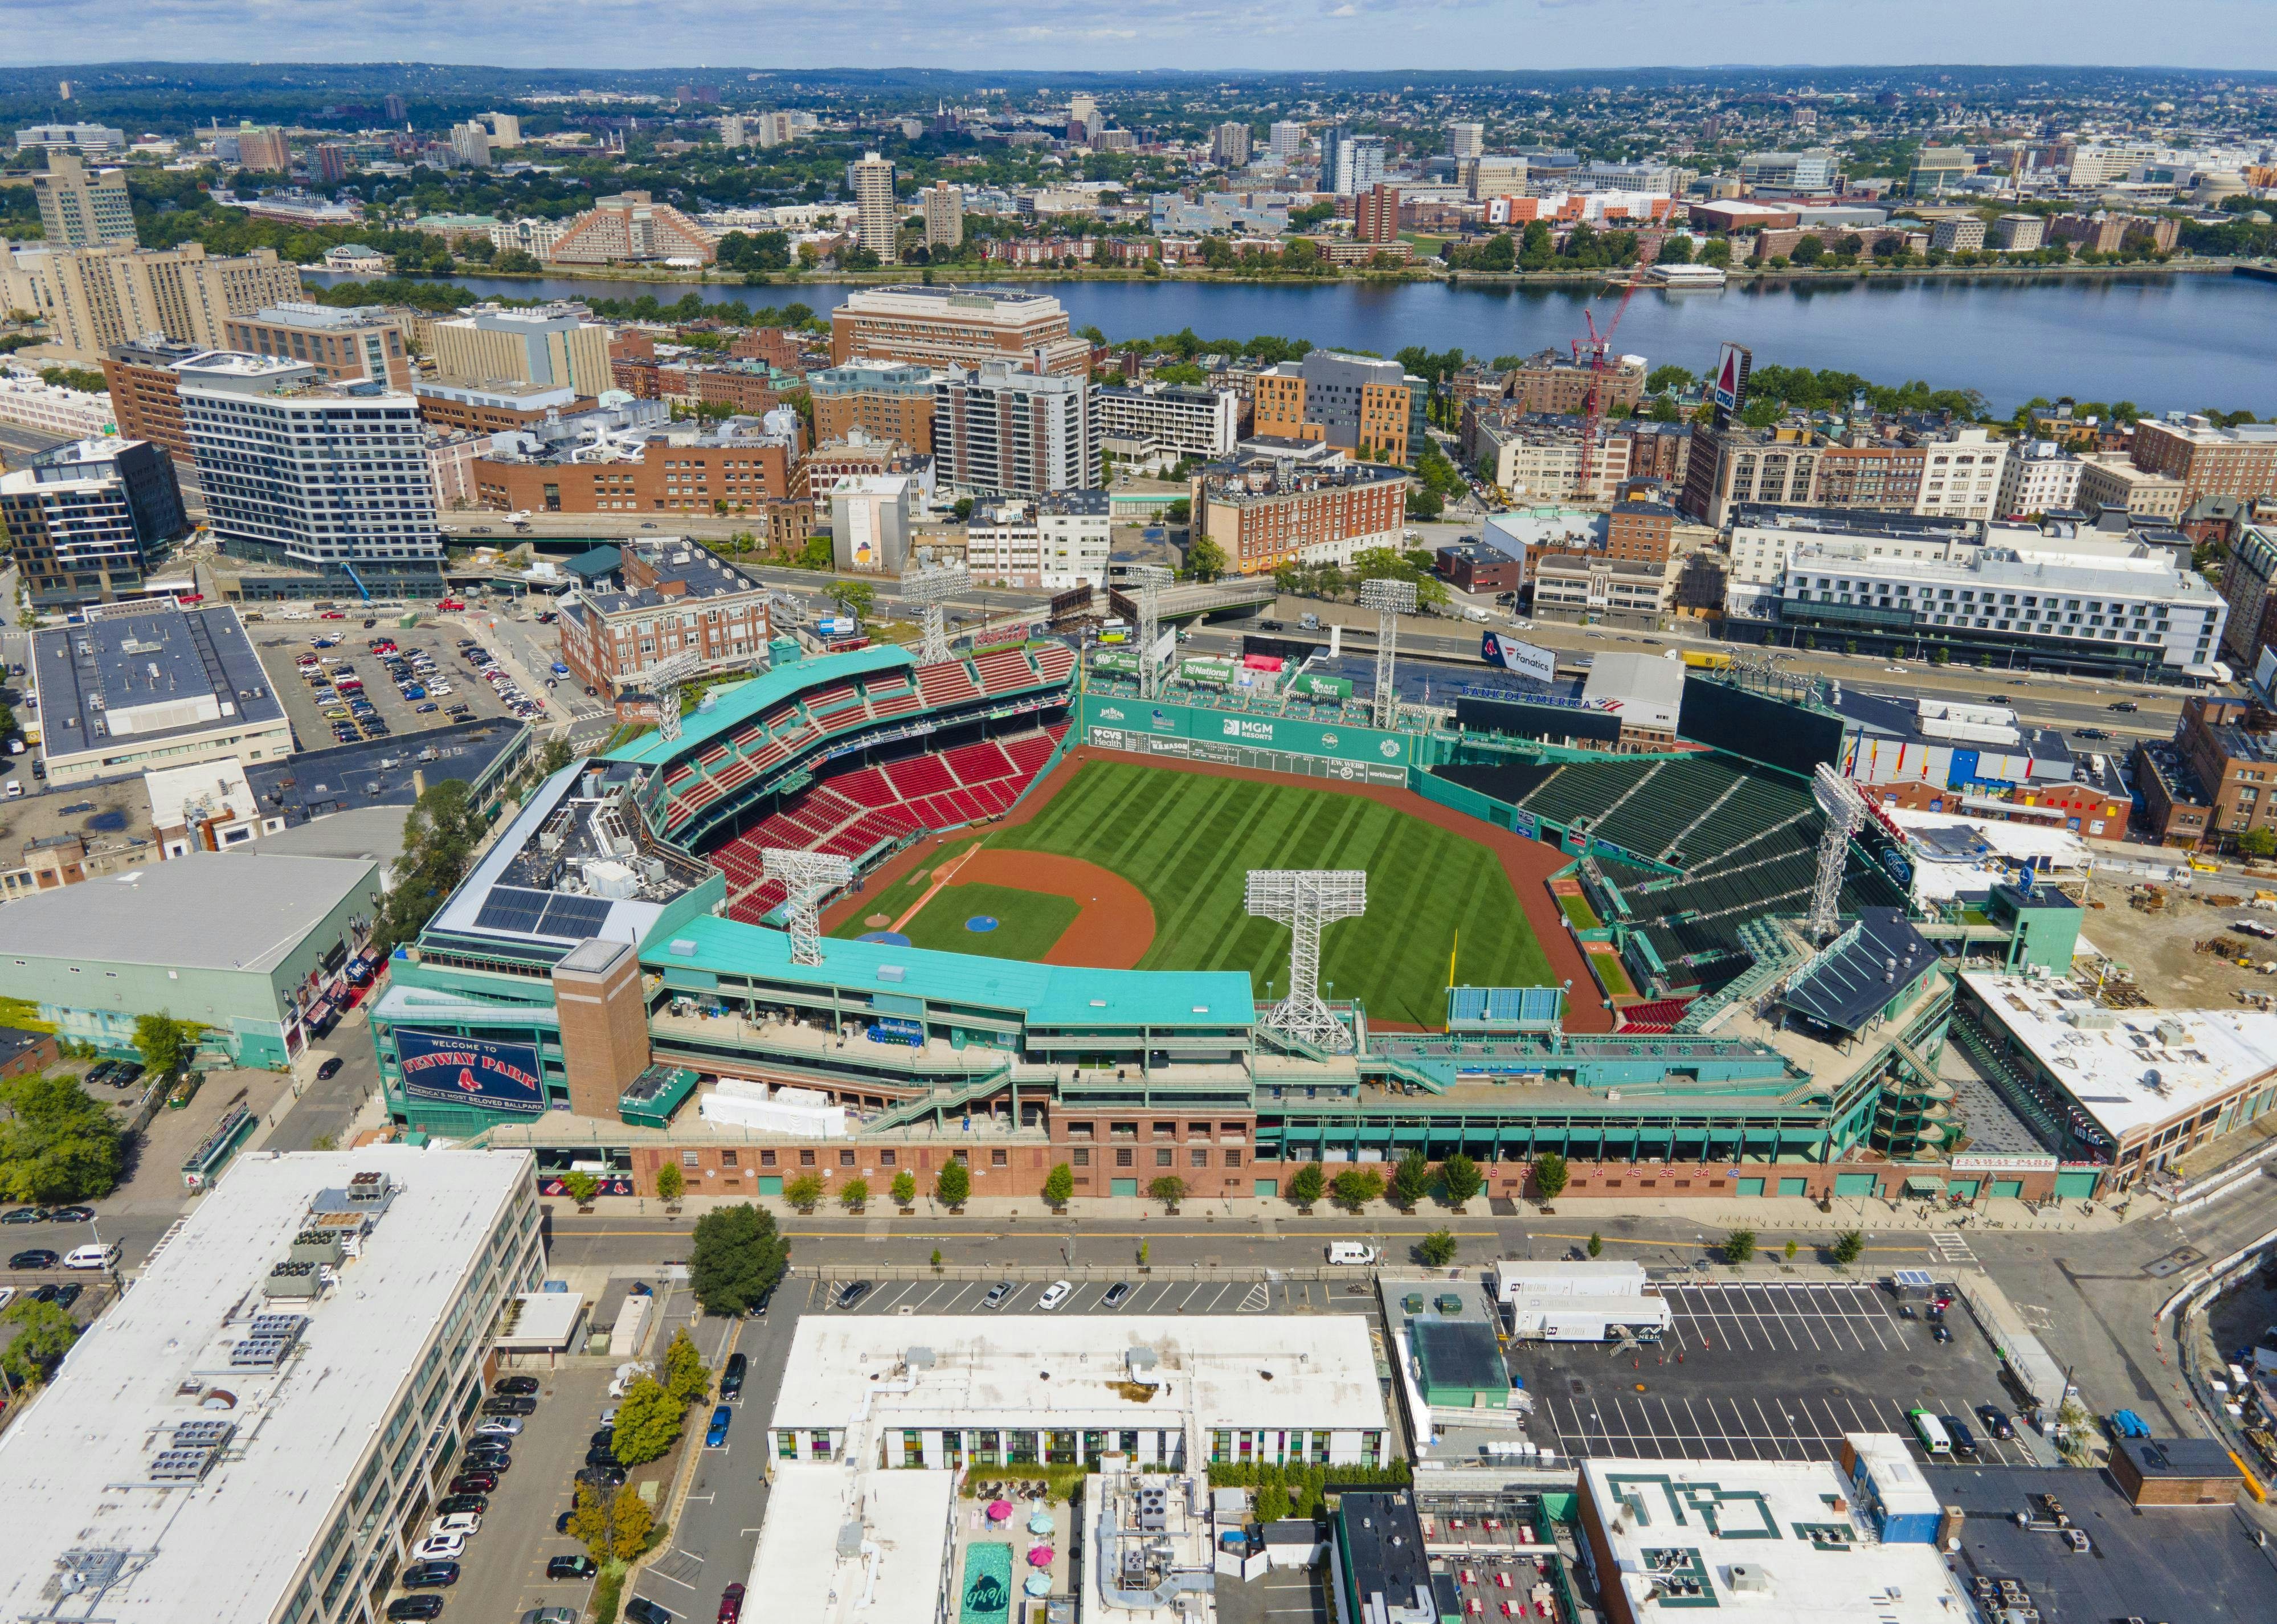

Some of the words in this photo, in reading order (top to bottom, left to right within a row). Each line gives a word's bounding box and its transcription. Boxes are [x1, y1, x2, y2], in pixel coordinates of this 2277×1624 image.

[1716, 390, 1734, 408] CITGO
[2165, 603, 2218, 612] Commonwealth
[1515, 652, 1549, 672] Fanatics
[1195, 666, 1229, 677] National
[1462, 685, 1501, 699] BANK
[1505, 690, 1522, 701] OF
[1526, 693, 1591, 710] AMERICA
[1242, 721, 1273, 734] MGM
[1102, 730, 1122, 740] CVS
[1241, 732, 1273, 741] RESORTS
[1094, 737, 1122, 748] Health
[1369, 771, 1402, 780] workhuman
[1888, 854, 1904, 878] Ford
[351, 963, 366, 977] 1947
[432, 1040, 480, 1050] WELCOME
[402, 1052, 477, 1074] FENWAY
[481, 1056, 538, 1090] PARK
[408, 1086, 445, 1098] AMERICA'S
[469, 1096, 502, 1106] BELOVED
[504, 1101, 543, 1110] BALLPARK
[2074, 1126, 2086, 1140] RED
[2087, 1132, 2100, 1146] SOX
[1956, 1157, 2011, 1166] FENWAY
[2094, 1151, 2108, 1164] KIDS
[1385, 1168, 1394, 1177] 9
[1490, 1168, 1498, 1177] 8
[1592, 1169, 1603, 1177] 14
[1625, 1168, 1642, 1177] 45
[1659, 1168, 1675, 1177] 26
[1694, 1168, 1710, 1177] 34
[1726, 1168, 1740, 1177] 42
[967, 1587, 1008, 1610] Verb
